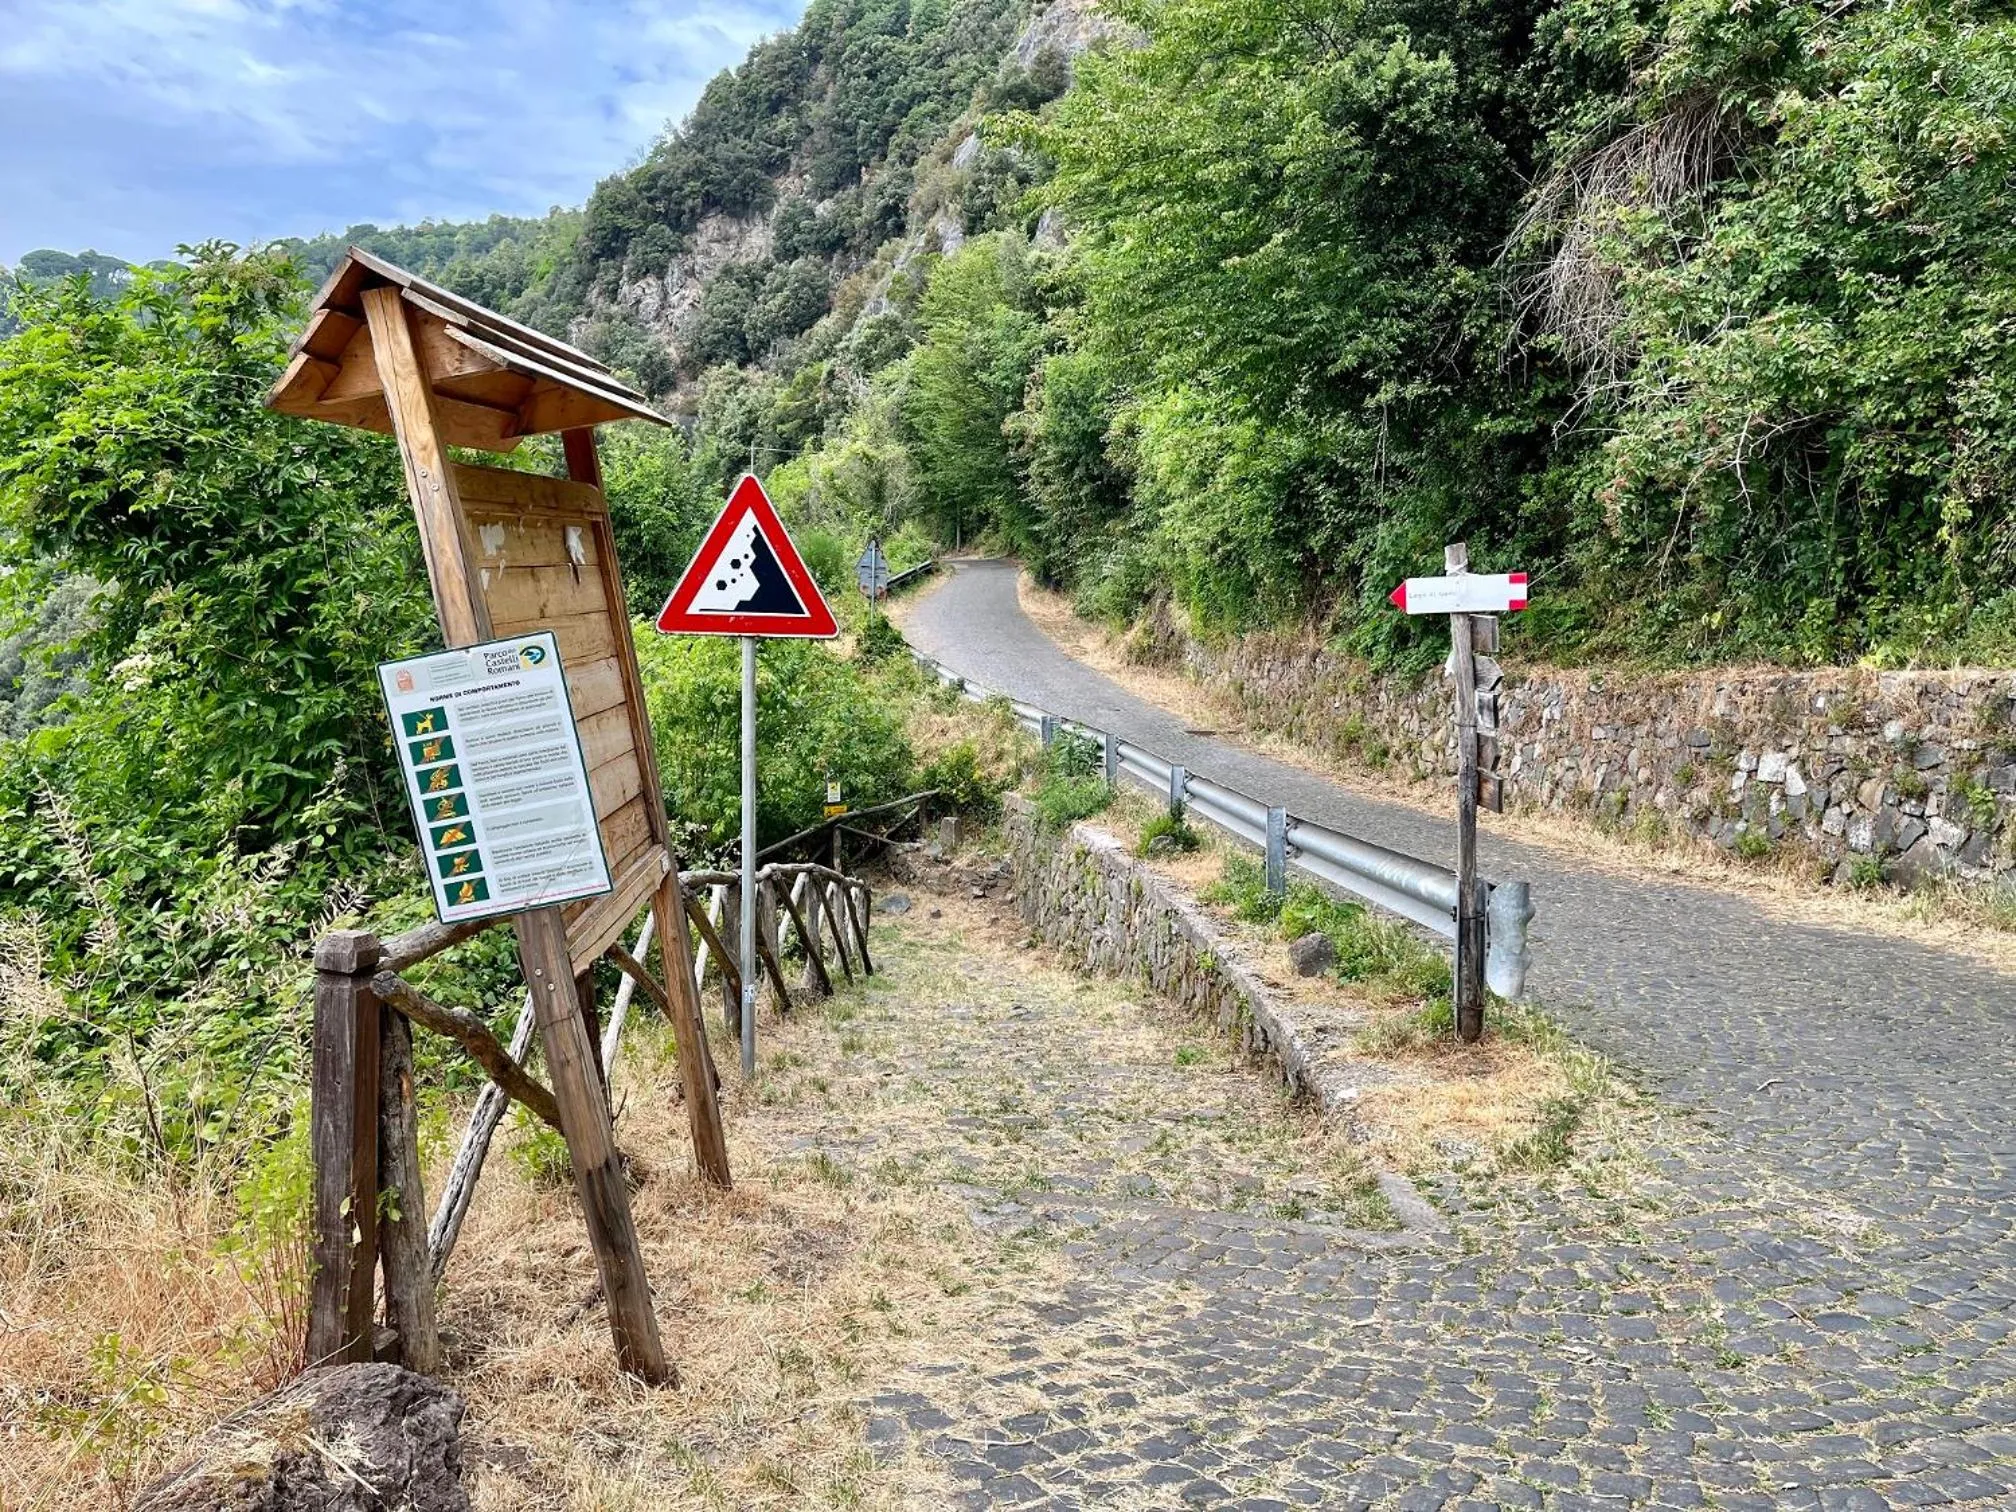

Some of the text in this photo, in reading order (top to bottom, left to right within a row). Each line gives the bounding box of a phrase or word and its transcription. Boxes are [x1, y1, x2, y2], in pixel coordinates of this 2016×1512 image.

[483, 650, 508, 660] Parco
[485, 655, 519, 668] Castelli
[462, 680, 520, 696] COMPORTAMENTO
